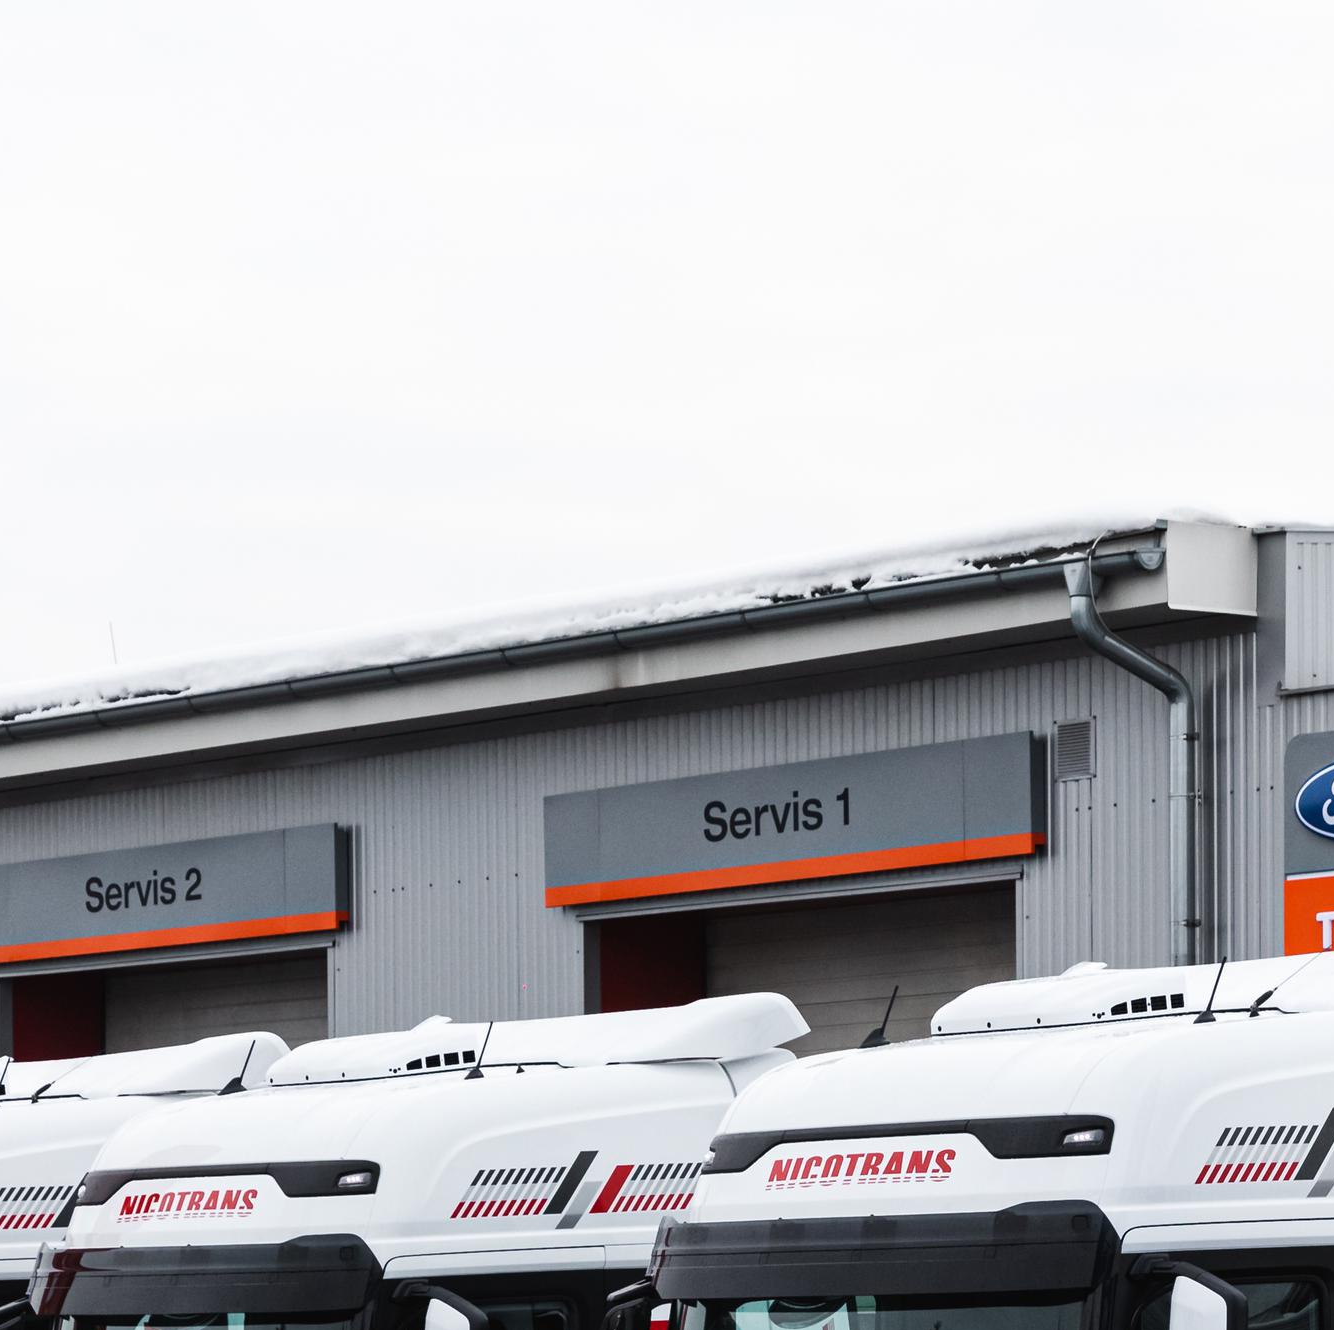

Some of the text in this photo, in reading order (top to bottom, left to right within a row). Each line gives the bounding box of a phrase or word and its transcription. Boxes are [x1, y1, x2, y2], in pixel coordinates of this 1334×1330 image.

[703, 788, 852, 842] Servis 1
[84, 868, 203, 914] Servis 2
[766, 1149, 956, 1191] NICOTRANS
[117, 1189, 258, 1223] NICOTRANS
